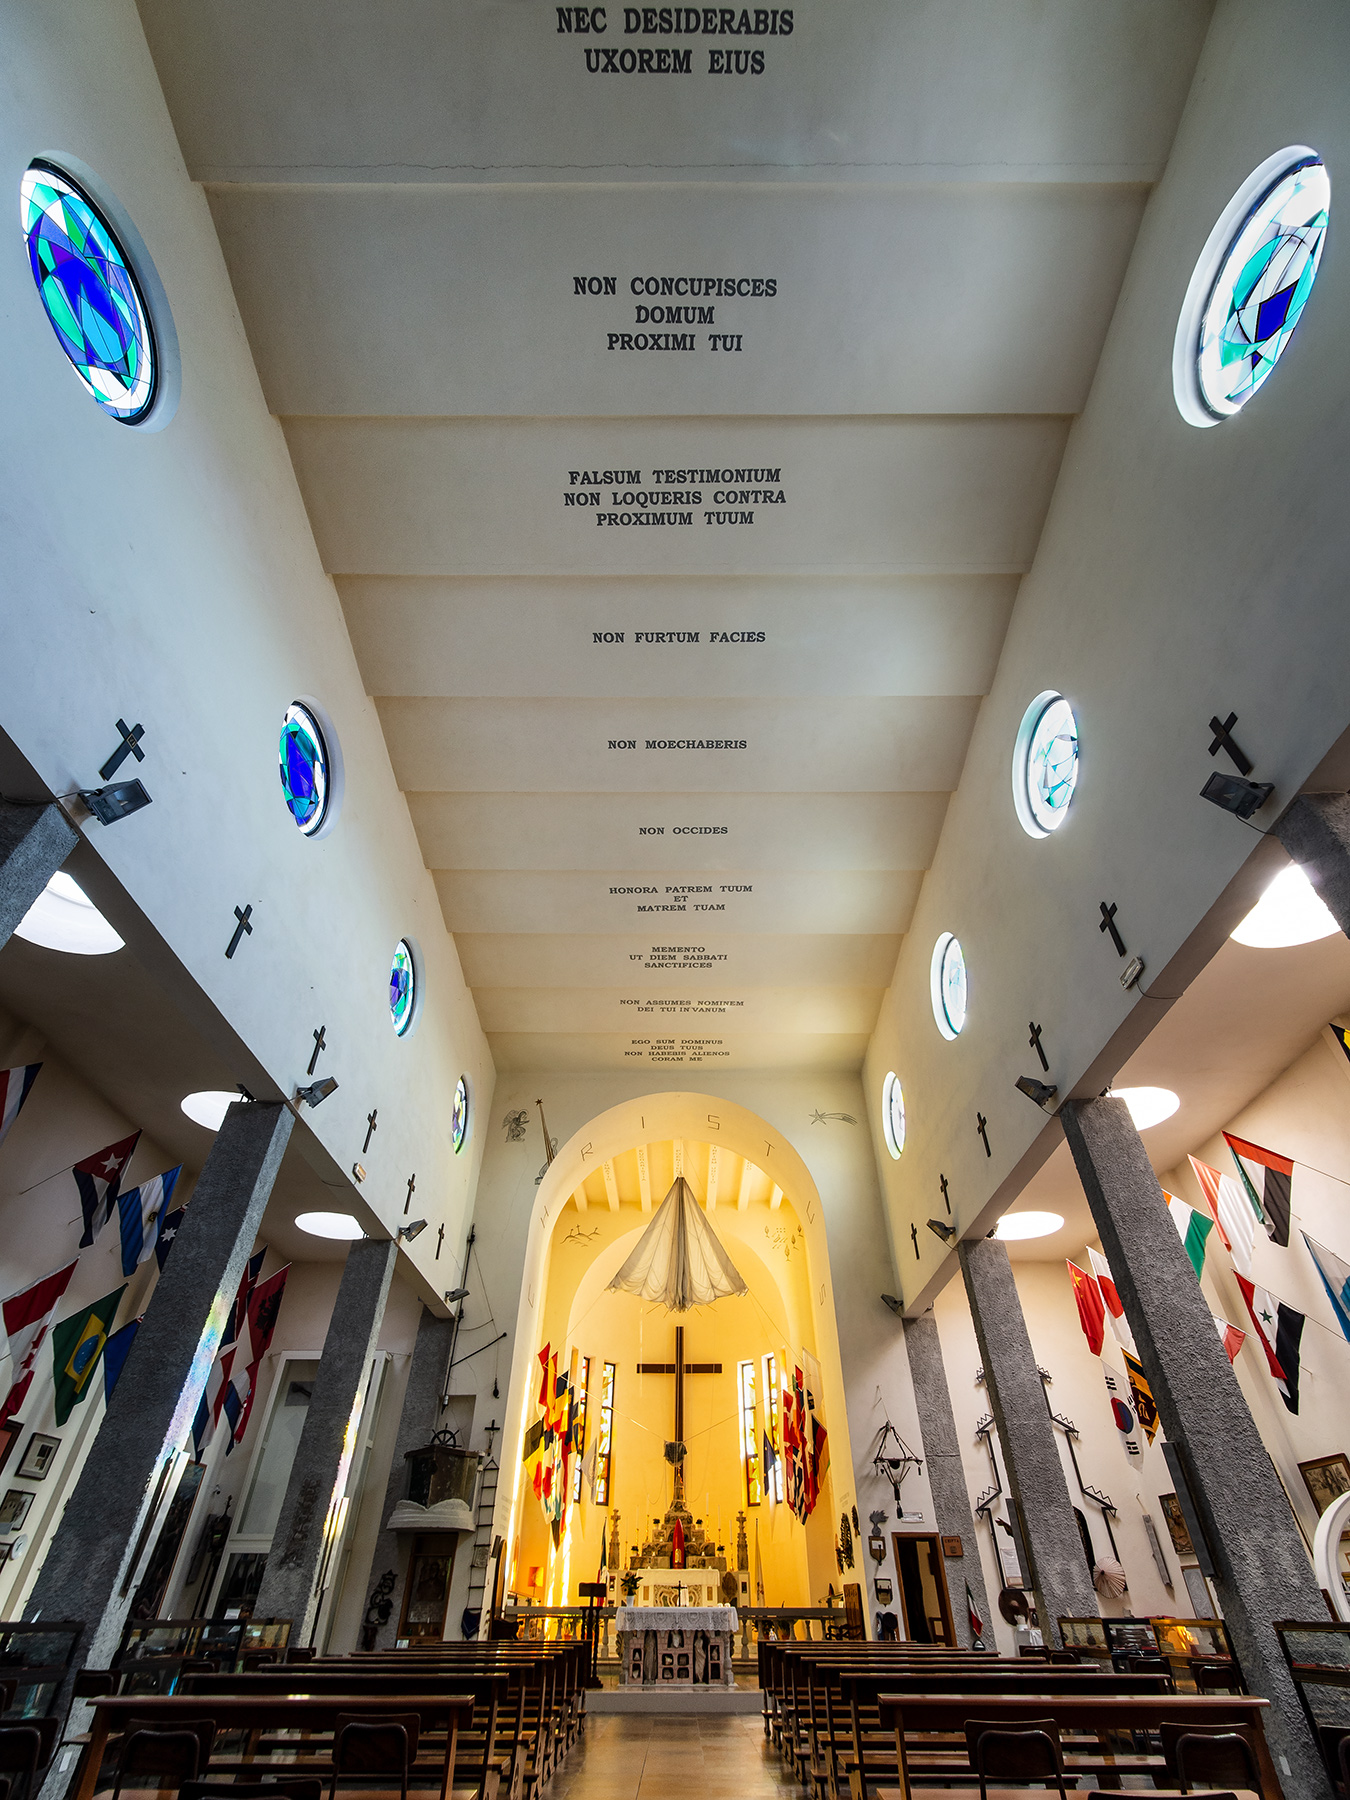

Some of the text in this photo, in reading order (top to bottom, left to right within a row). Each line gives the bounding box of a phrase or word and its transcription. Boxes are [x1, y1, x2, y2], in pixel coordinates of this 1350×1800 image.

[556, 7, 793, 35] NEC DESIDERABIS
[584, 49, 765, 75] UXOREM EIUS
[573, 277, 777, 297] NON CONCUPISCES
[635, 305, 714, 324] DOMUM
[607, 333, 742, 351] PROXIMI TUI
[568, 468, 781, 485] FALSUM TESTIMONIUM
[564, 490, 786, 508] NON LOQUERIS CONTRA
[596, 511, 754, 526] PROXIMUM TUUM
[593, 632, 765, 643] NON FURTUM FACIES
[608, 740, 747, 749] NON MOECHABERIS
[609, 885, 753, 895] HONORA PATREM TUUM
[673, 895, 689, 903] ET
[637, 905, 687, 913] MATREM
